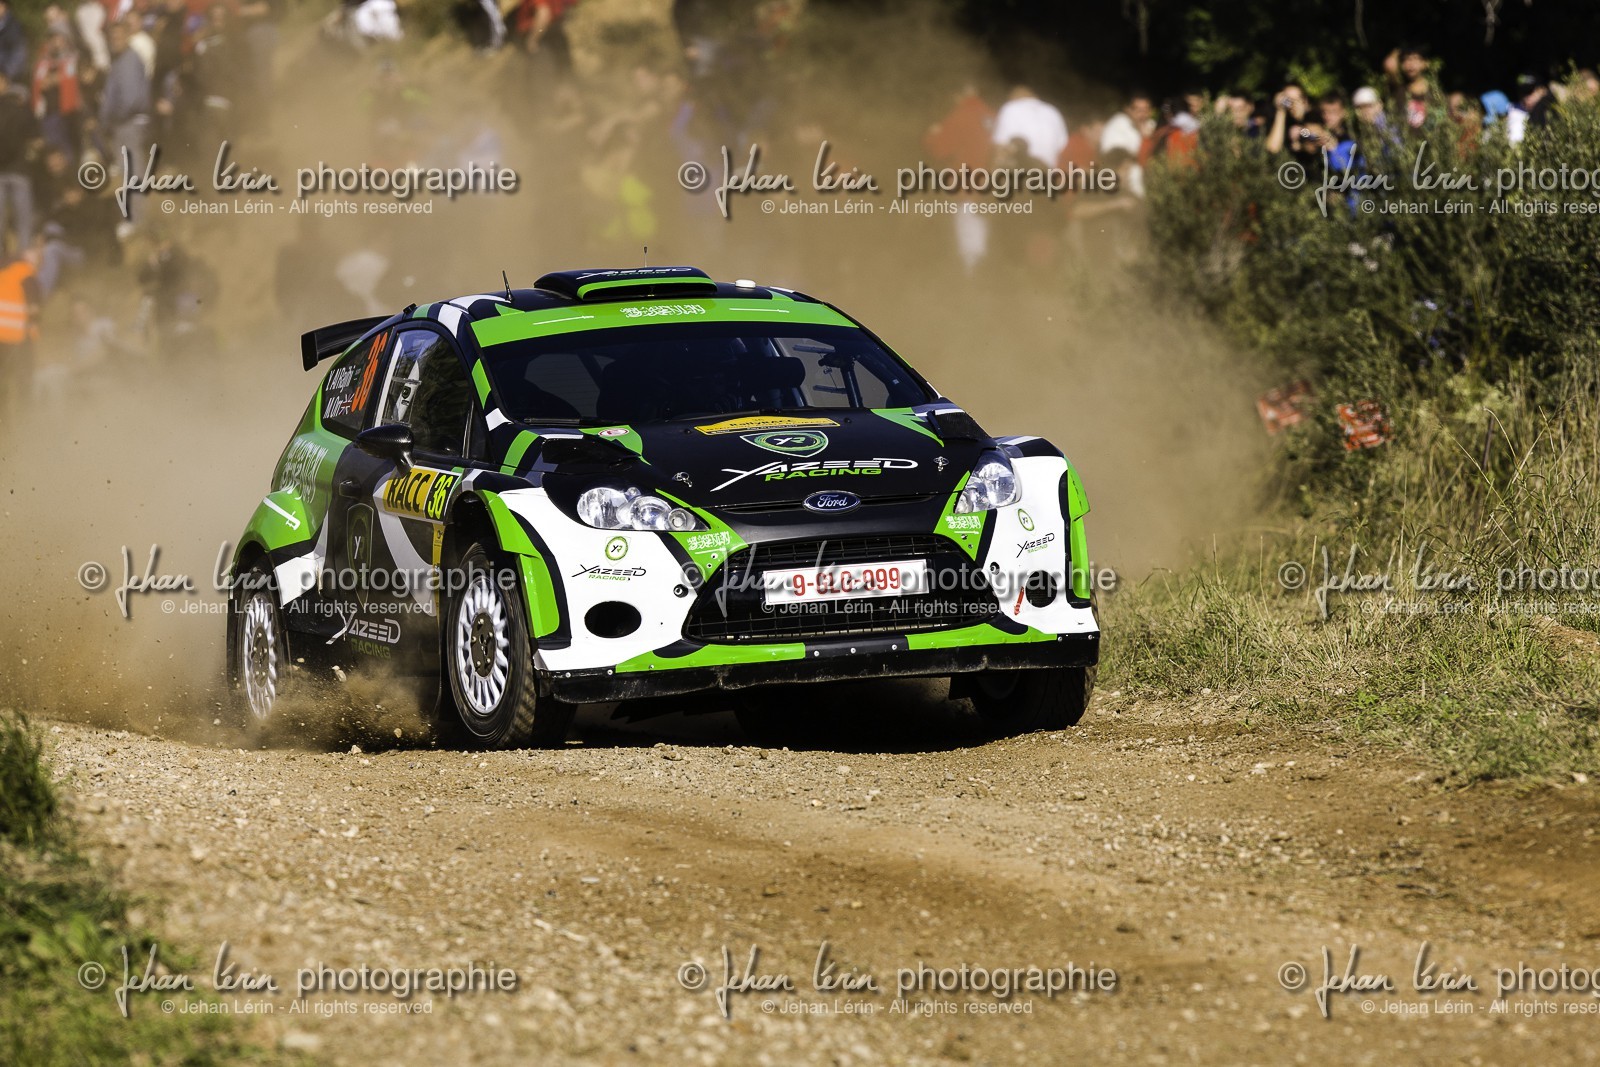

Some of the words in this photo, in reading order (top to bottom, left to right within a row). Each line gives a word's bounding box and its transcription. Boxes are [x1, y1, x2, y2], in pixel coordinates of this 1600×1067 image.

[351, 332, 388, 412] 36
[710, 458, 918, 492] YAZEED
[765, 467, 882, 482] RACING
[387, 472, 431, 513] RACC
[427, 474, 452, 520] 36
[817, 494, 848, 508] Ford
[571, 564, 647, 578] YAZEED
[326, 606, 401, 645] YAZEED
[351, 638, 391, 659] RACING
